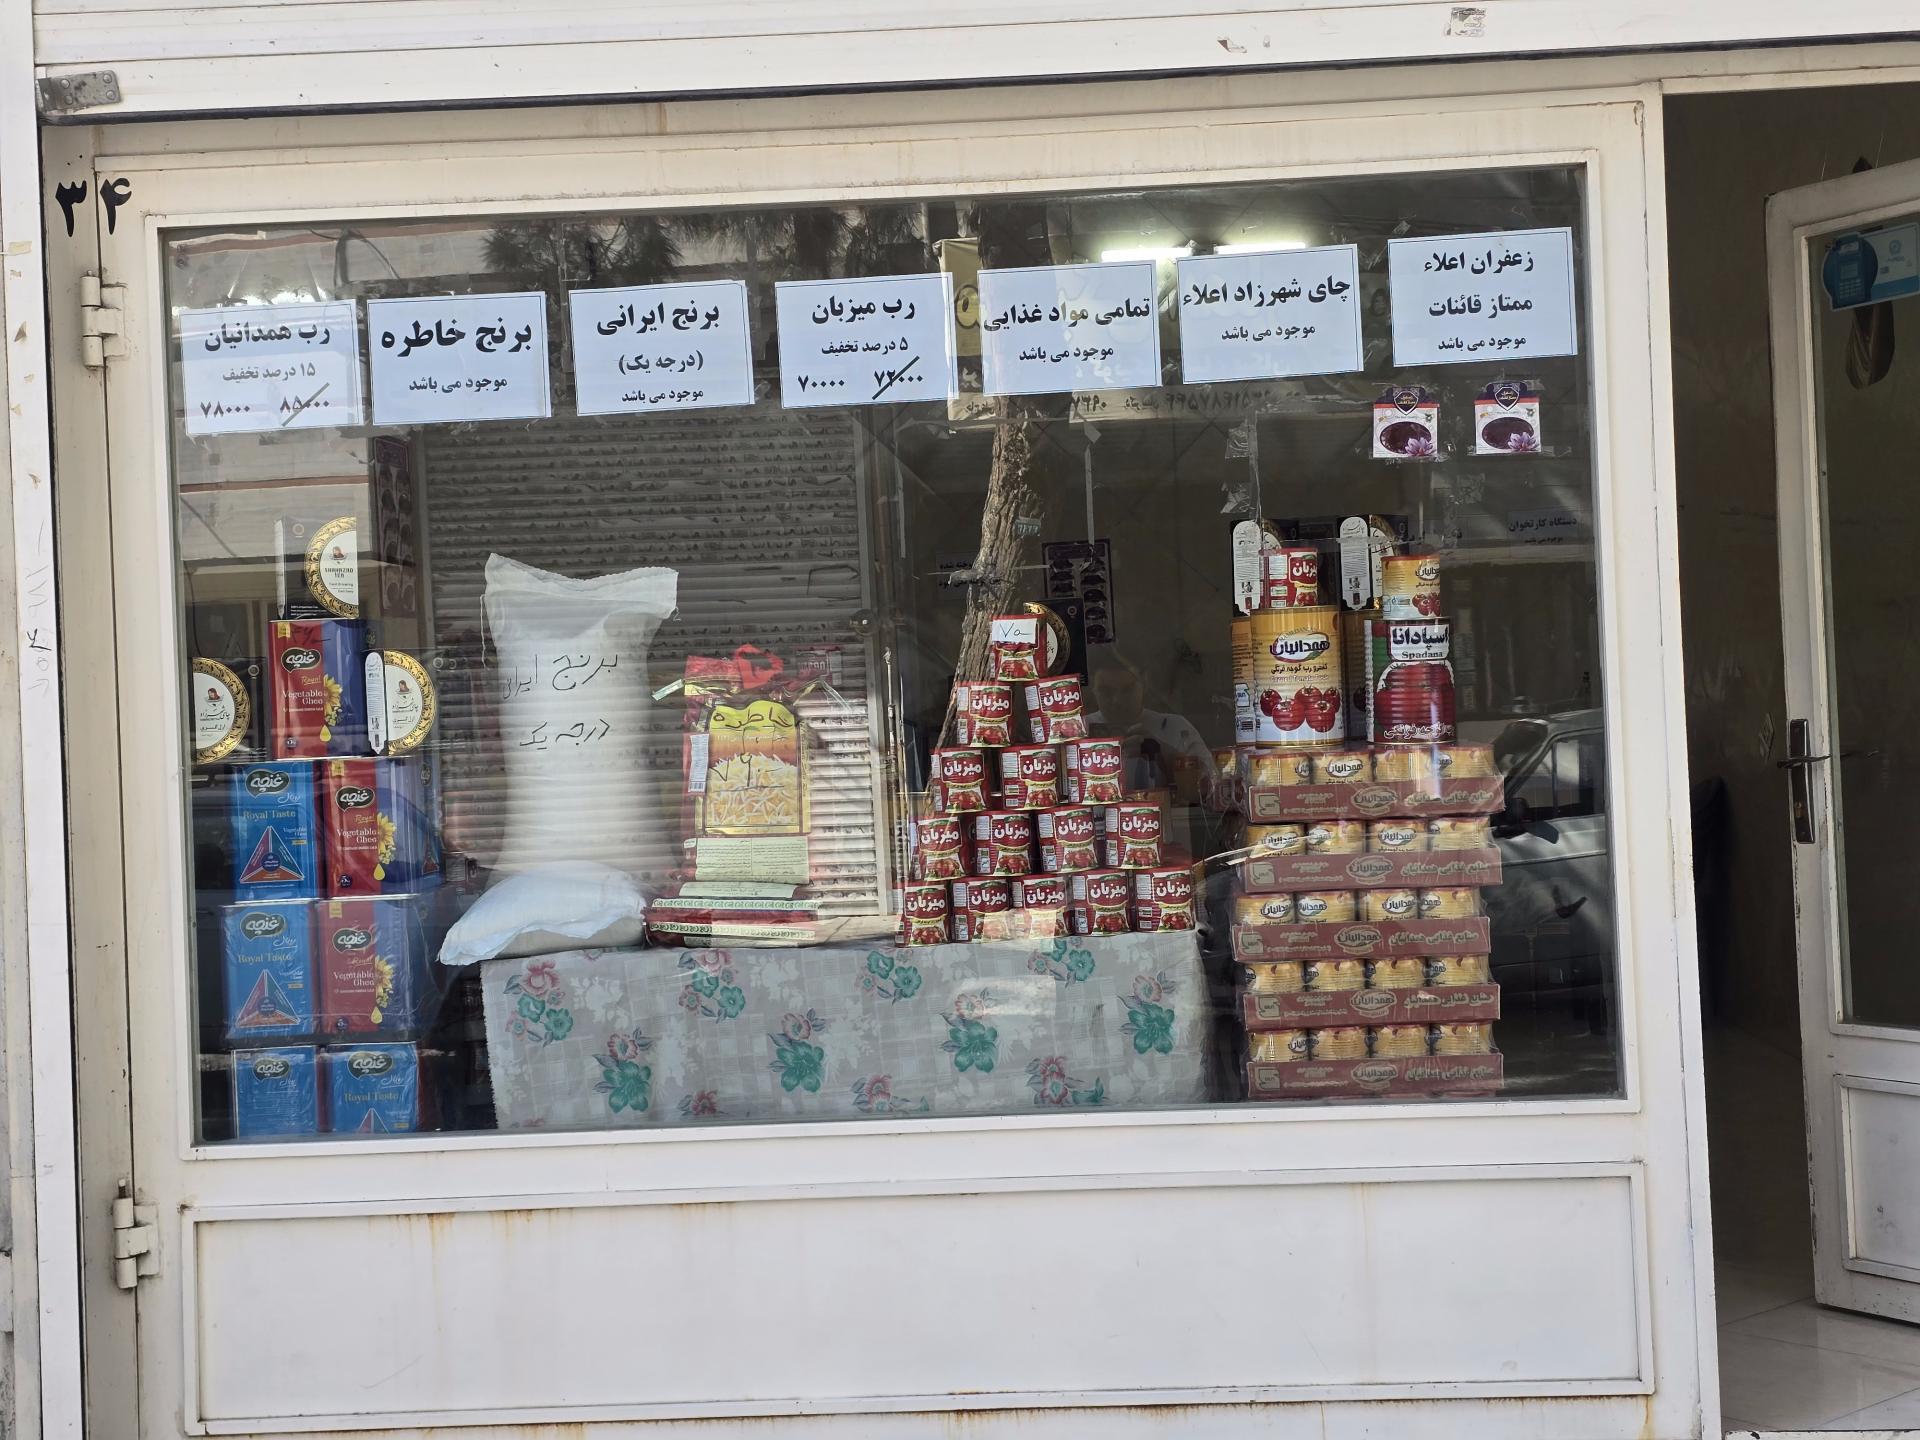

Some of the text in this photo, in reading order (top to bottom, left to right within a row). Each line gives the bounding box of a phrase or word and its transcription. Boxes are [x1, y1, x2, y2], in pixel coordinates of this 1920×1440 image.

[55, 178, 132, 237] ۳۴
[1424, 249, 1534, 275] زعفران اعلاء
[1180, 274, 1351, 309] چای شهرزاد اعلاء
[811, 295, 916, 325] رب میزبان
[983, 295, 1153, 332] تمامی مواد غذایی
[1428, 293, 1533, 319] ممتاز قائنات
[596, 299, 720, 336] برنج ایرانی
[205, 322, 329, 351] رب همدانیان
[381, 317, 532, 358] برنج خاطره
[1221, 326, 1316, 342] موجود می باشد
[821, 336, 909, 357] ۵ درصد تخفیف
[1438, 336, 1527, 352] موجود می باشد
[618, 349, 704, 376] (درجه یک)
[1019, 346, 1114, 363] موجود می باشد
[222, 364, 315, 382] ۱۵ درصد تخفیف
[408, 376, 508, 394] موجود می باشد
[798, 375, 845, 392] ۷۰۰۰۰
[621, 389, 704, 404] موجود می باشد
[200, 401, 250, 418] ۷۸۰۰۰
[1293, 561, 1317, 578] یزبان
[1392, 626, 1448, 650] اسپادانا
[1269, 639, 1330, 657] همدانیان
[1402, 651, 1443, 660] Spadana
[286, 652, 315, 667] غنچه
[503, 654, 618, 699] برنج ایرانی
[972, 694, 1010, 711] میزبان
[1043, 689, 1080, 706] میزبان
[519, 719, 610, 750] درجه یک
[943, 760, 982, 776] میزبان
[1022, 759, 1056, 775] میزبان
[1082, 753, 1120, 768] میزبان
[250, 774, 284, 792] غنچه
[340, 790, 370, 806] غنچه
[994, 823, 1030, 839] میزبان
[1057, 819, 1093, 835] میزبان
[1122, 815, 1159, 832] میزبان
[920, 828, 960, 845] میزبان
[971, 888, 1007, 905] میزبان
[1026, 888, 1064, 905] میزبان
[1090, 882, 1127, 899] میزبان
[1156, 881, 1191, 898] میزبان
[907, 896, 946, 913] میزبان
[246, 917, 280, 935] غنچه
[337, 932, 367, 949] غنچه
[256, 1062, 285, 1077] غنچه
[353, 1056, 387, 1074] غنچه
